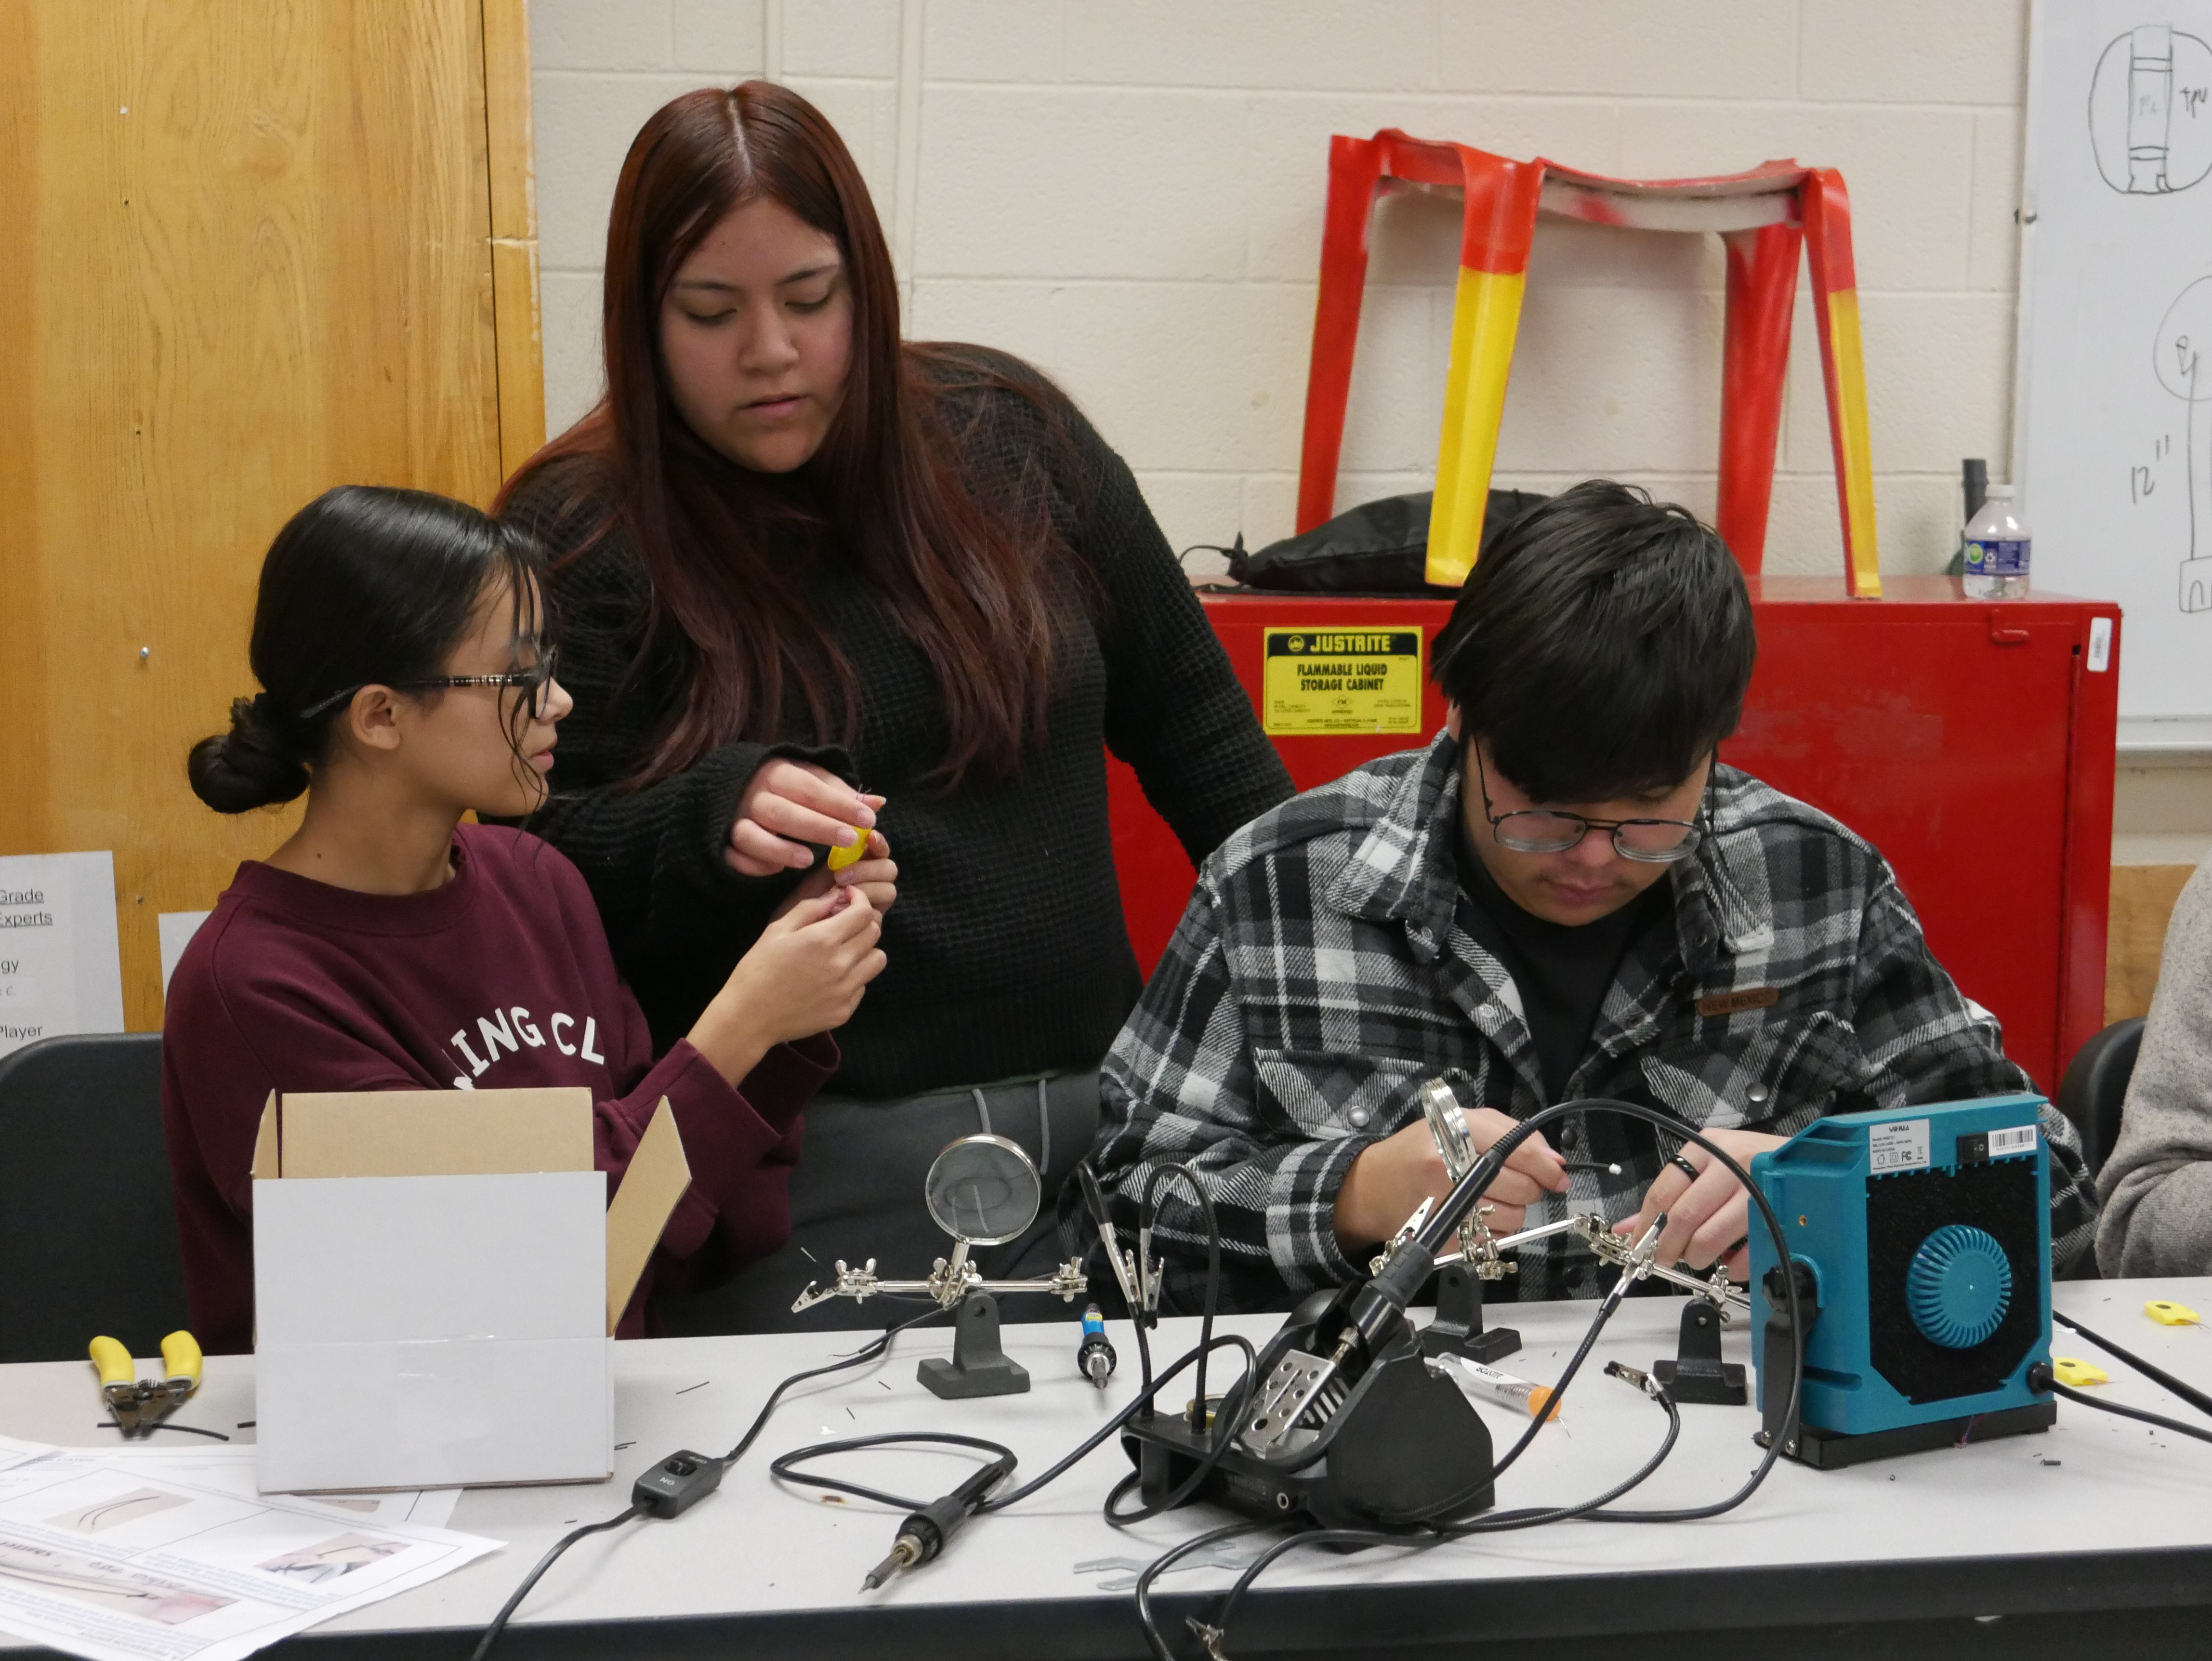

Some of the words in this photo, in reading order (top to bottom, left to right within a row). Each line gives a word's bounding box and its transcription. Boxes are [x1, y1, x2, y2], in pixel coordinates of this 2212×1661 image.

[1310, 634, 1391, 652] JUSTRITE
[1297, 663, 1353, 675] FLAMMABLE
[1356, 663, 1387, 675] LIQUID
[1301, 678, 1343, 690] STORAGE
[1346, 678, 1384, 690] CABINET
[659, 1476, 675, 1486] ON
